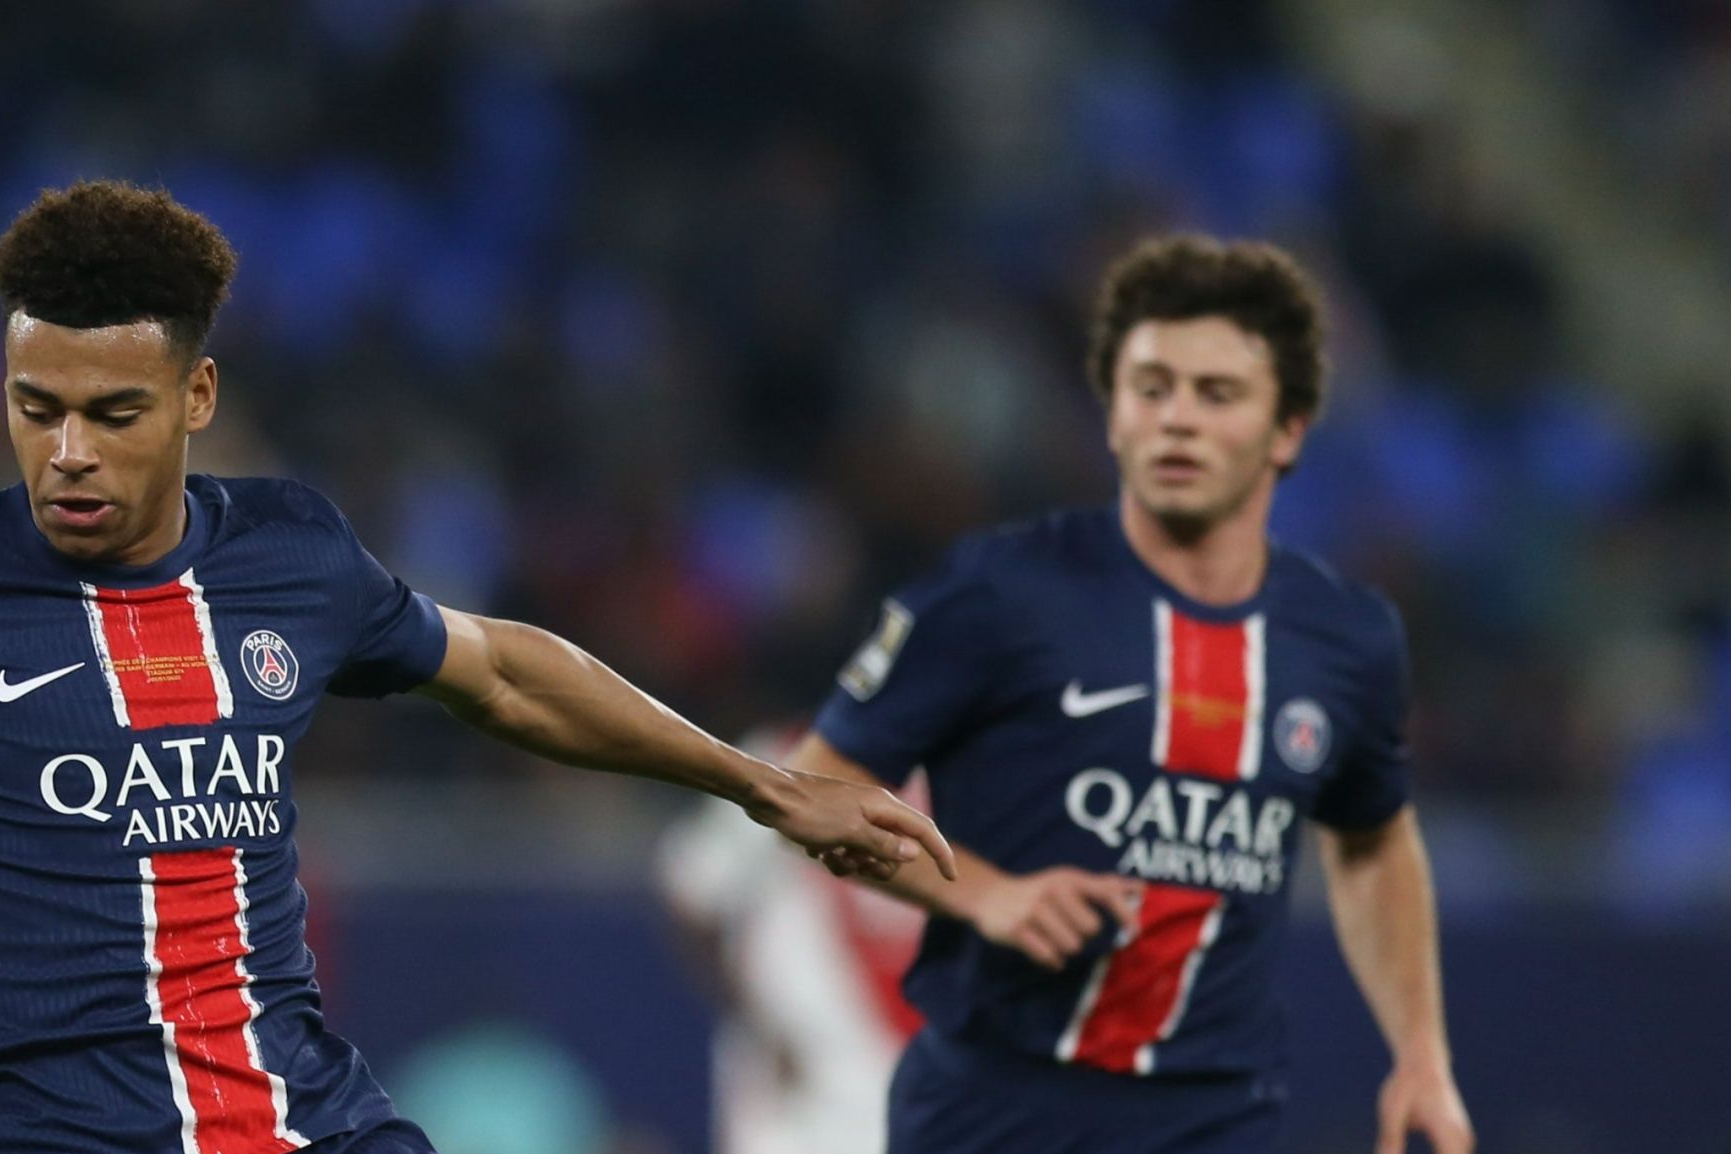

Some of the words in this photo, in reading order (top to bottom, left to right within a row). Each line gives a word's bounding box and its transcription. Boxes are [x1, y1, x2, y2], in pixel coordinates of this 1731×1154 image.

[246, 633, 283, 651] PARIS
[40, 734, 284, 822] QATAR
[1065, 768, 1295, 854] QATAR
[122, 799, 281, 847] AIRWAYS
